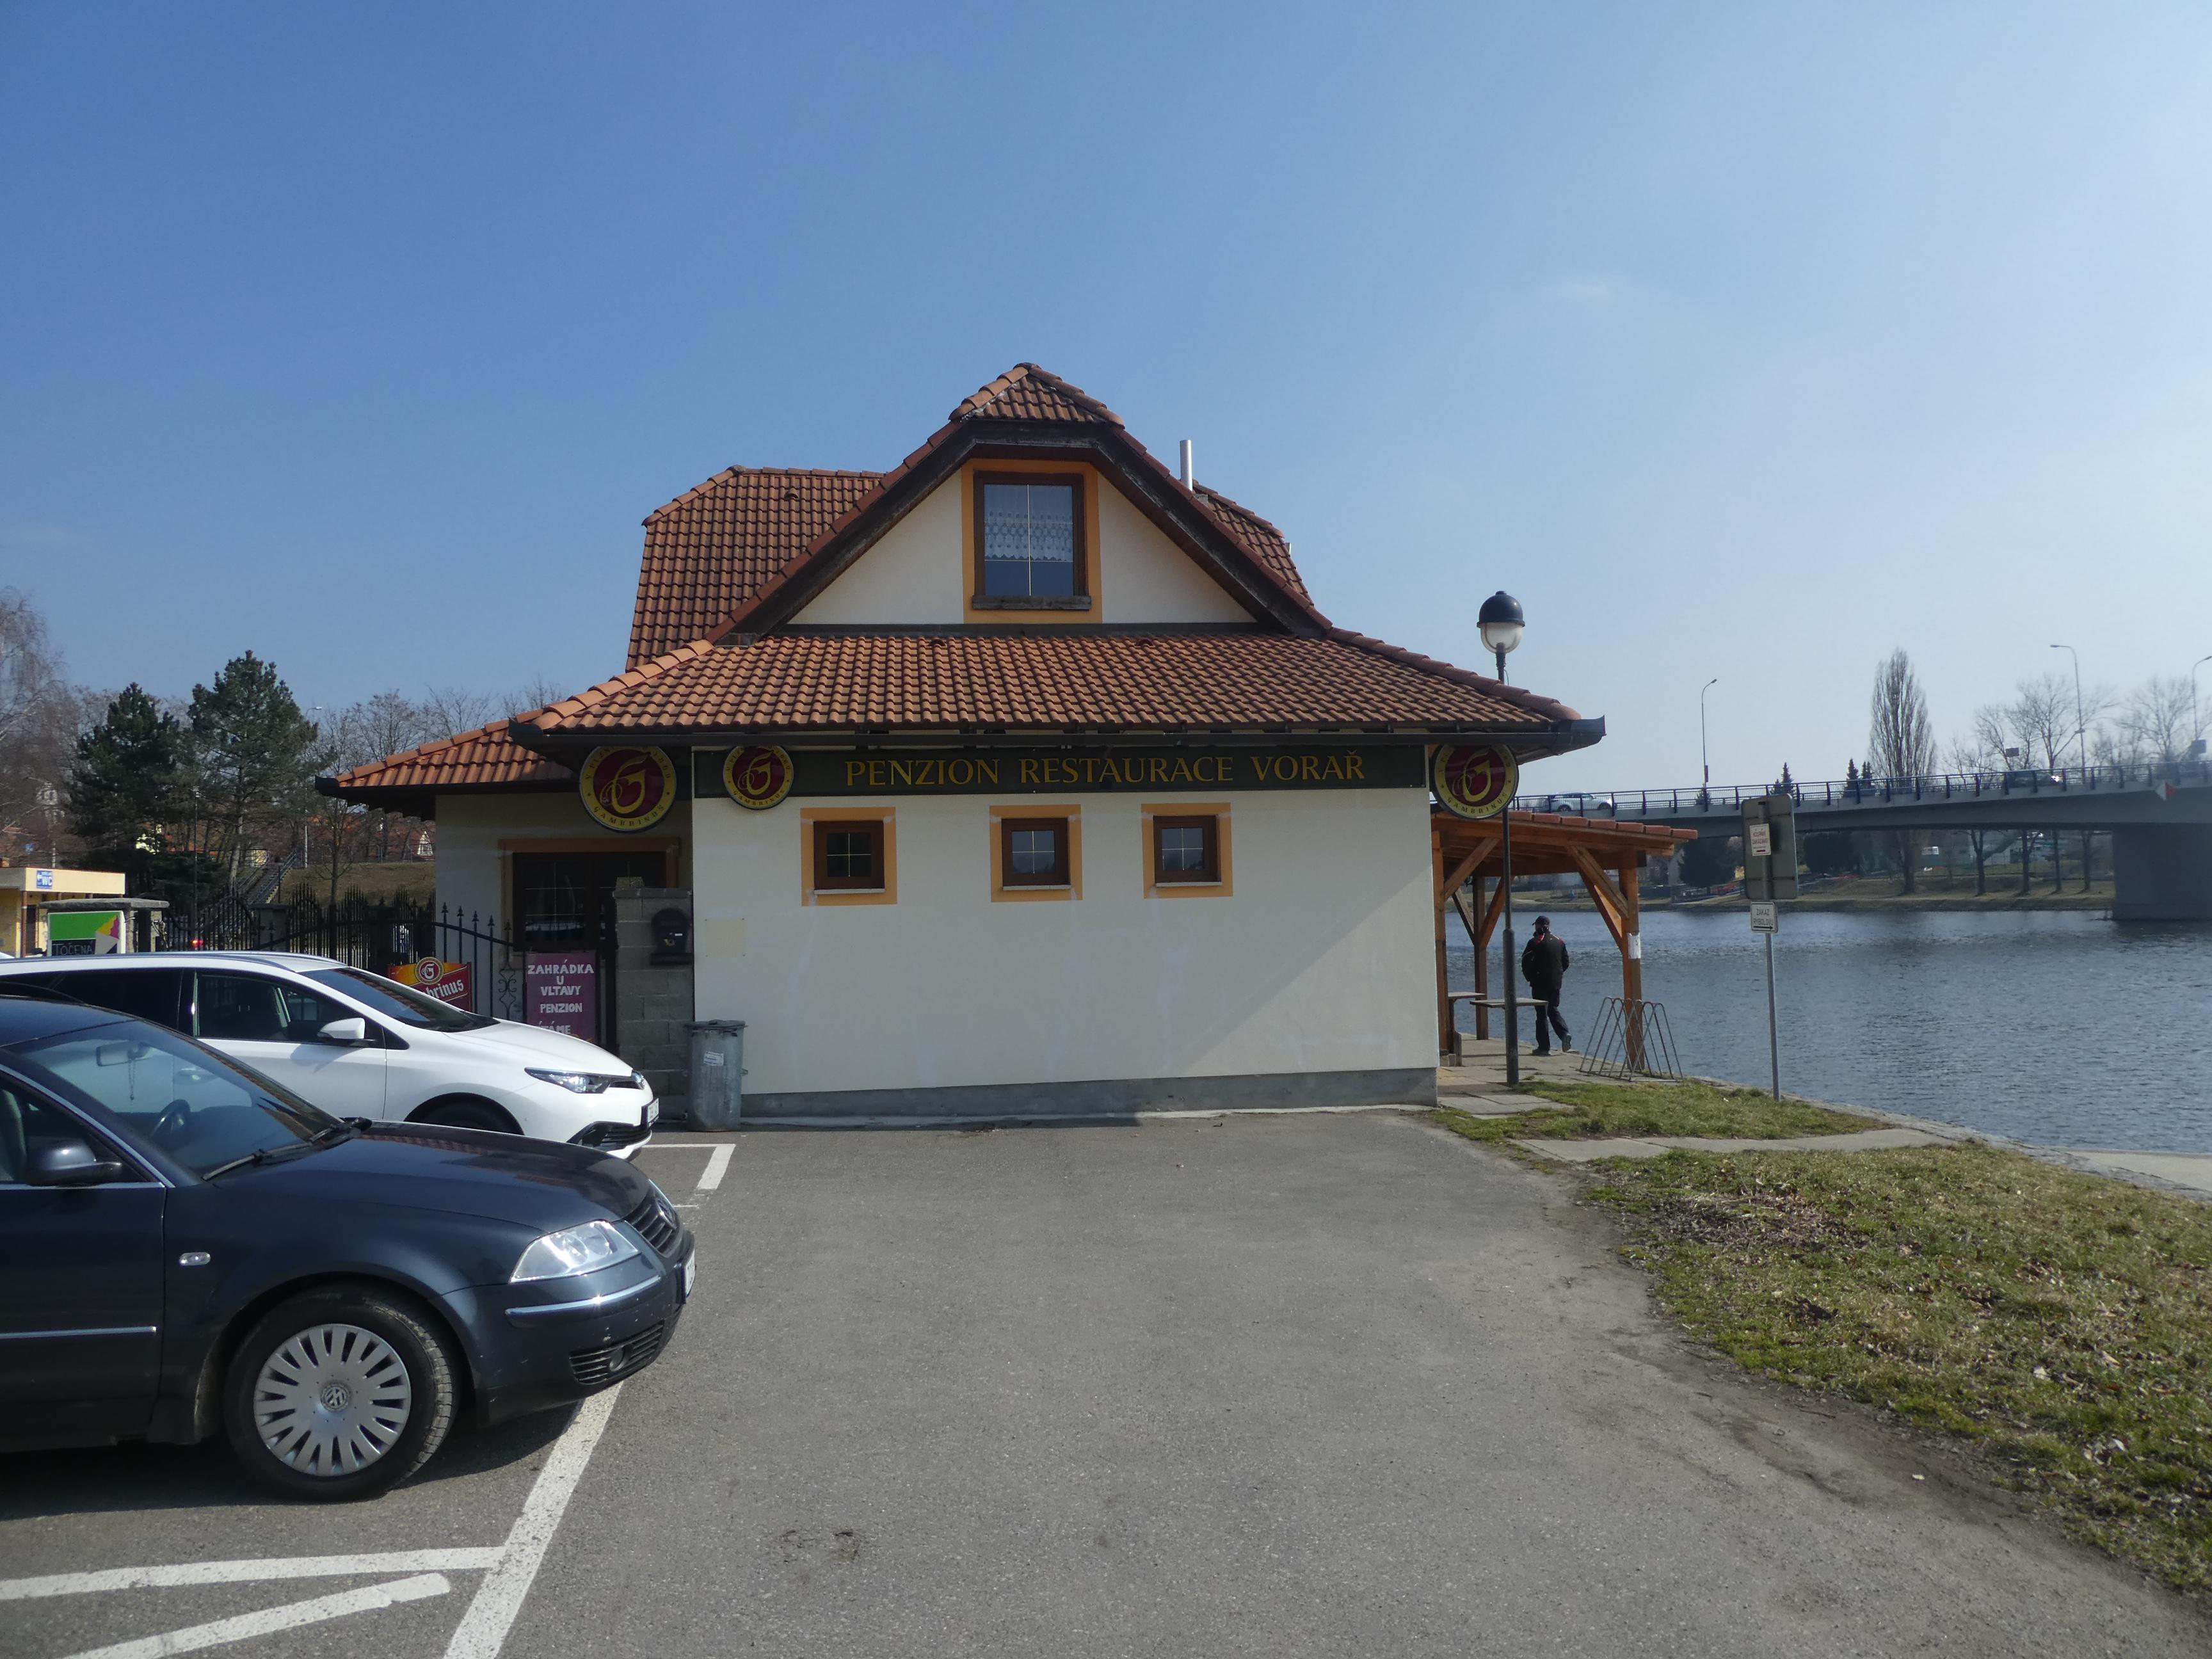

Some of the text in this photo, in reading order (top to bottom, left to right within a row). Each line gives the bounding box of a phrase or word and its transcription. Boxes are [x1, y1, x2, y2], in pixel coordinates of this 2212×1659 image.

[845, 749, 1365, 786] PENZION RESTAURACE VORAŘ
[732, 789, 785, 806] GAMBRINUS
[1447, 793, 1507, 813] GAMBRINUS
[593, 804, 664, 826] GAMBRINUS
[42, 876, 52, 886] WC
[527, 959, 595, 974] ZAHRÁDKA
[556, 975, 564, 985] U
[422, 979, 464, 999] brinus
[540, 986, 581, 996] VLTAVY
[540, 1003, 582, 1013] PENZION
